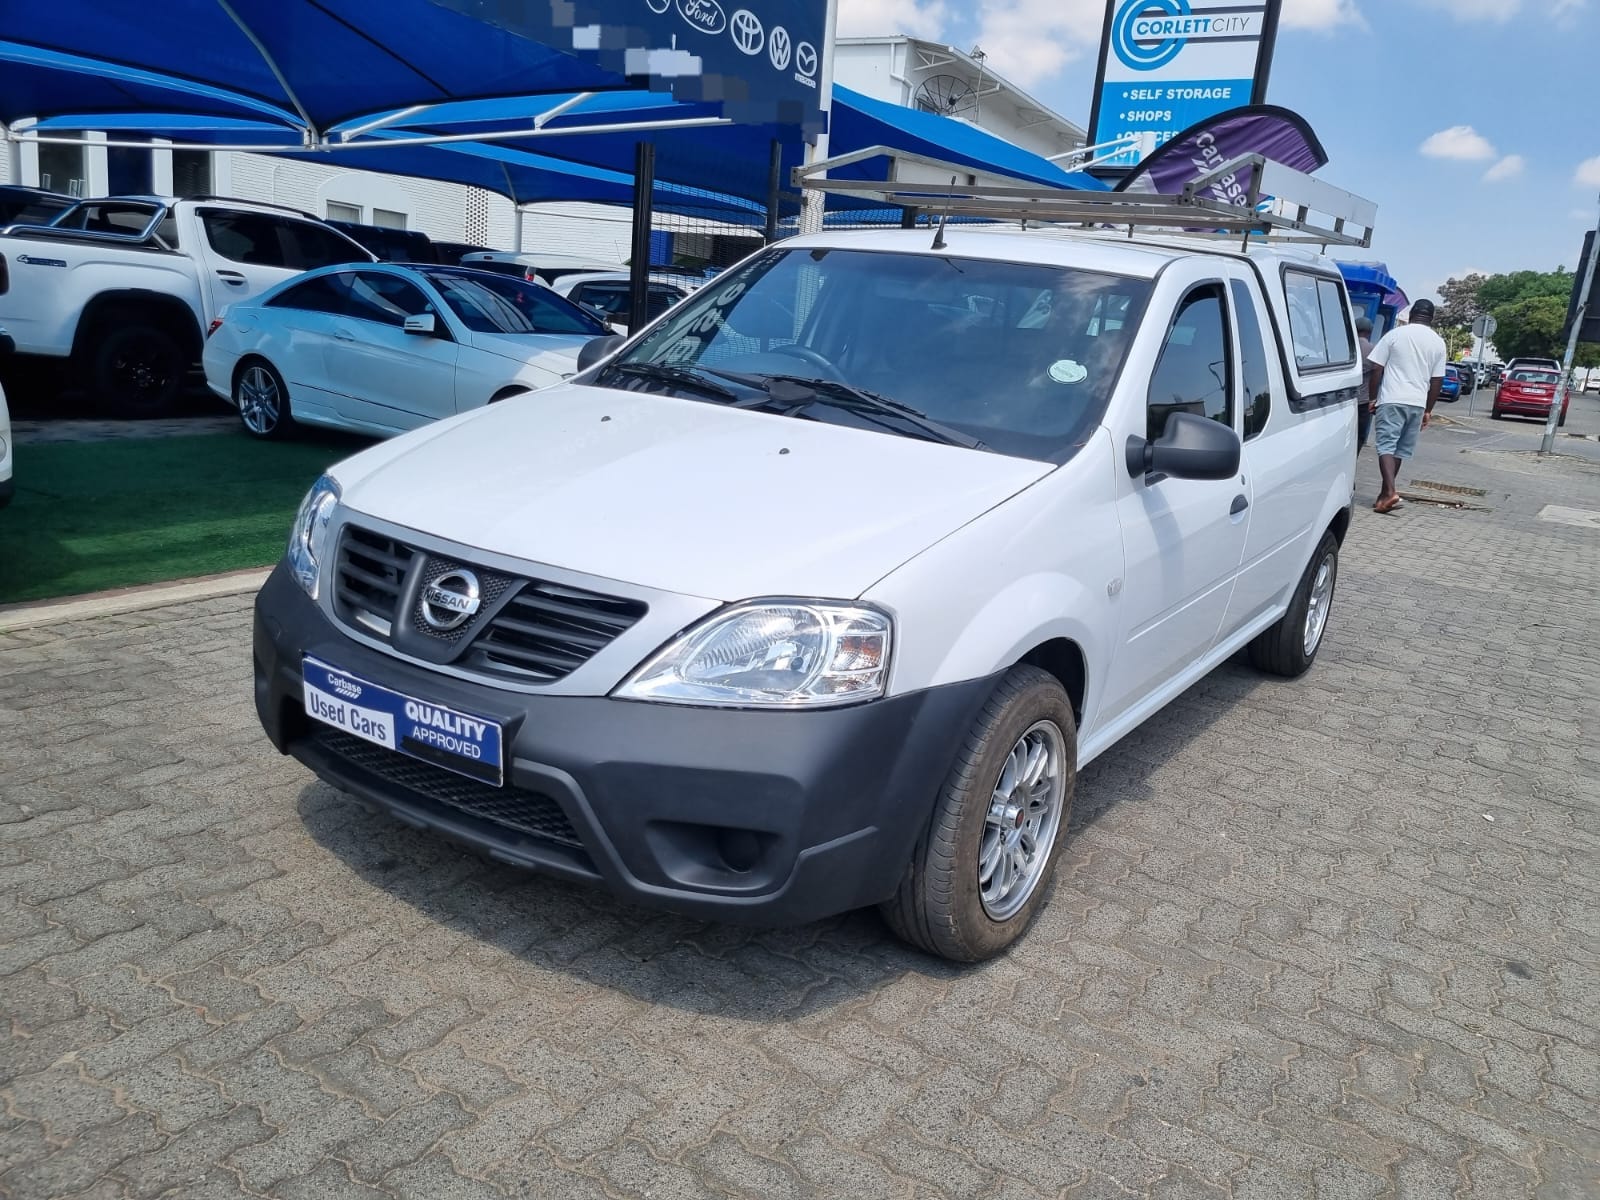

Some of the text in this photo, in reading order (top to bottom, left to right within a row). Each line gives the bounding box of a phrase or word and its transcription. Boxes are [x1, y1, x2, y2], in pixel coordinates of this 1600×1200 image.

[685, 0, 717, 27] Ford
[1130, 88, 1231, 100] SELF STORAGE
[1126, 110, 1172, 122] SHOPS
[1196, 132, 1247, 207] Carase
[424, 589, 470, 609] NISSAN
[327, 673, 362, 695] Carbase
[310, 691, 386, 742] Used Cars
[405, 701, 486, 741] QUALITY
[412, 725, 481, 759] APPROVED
